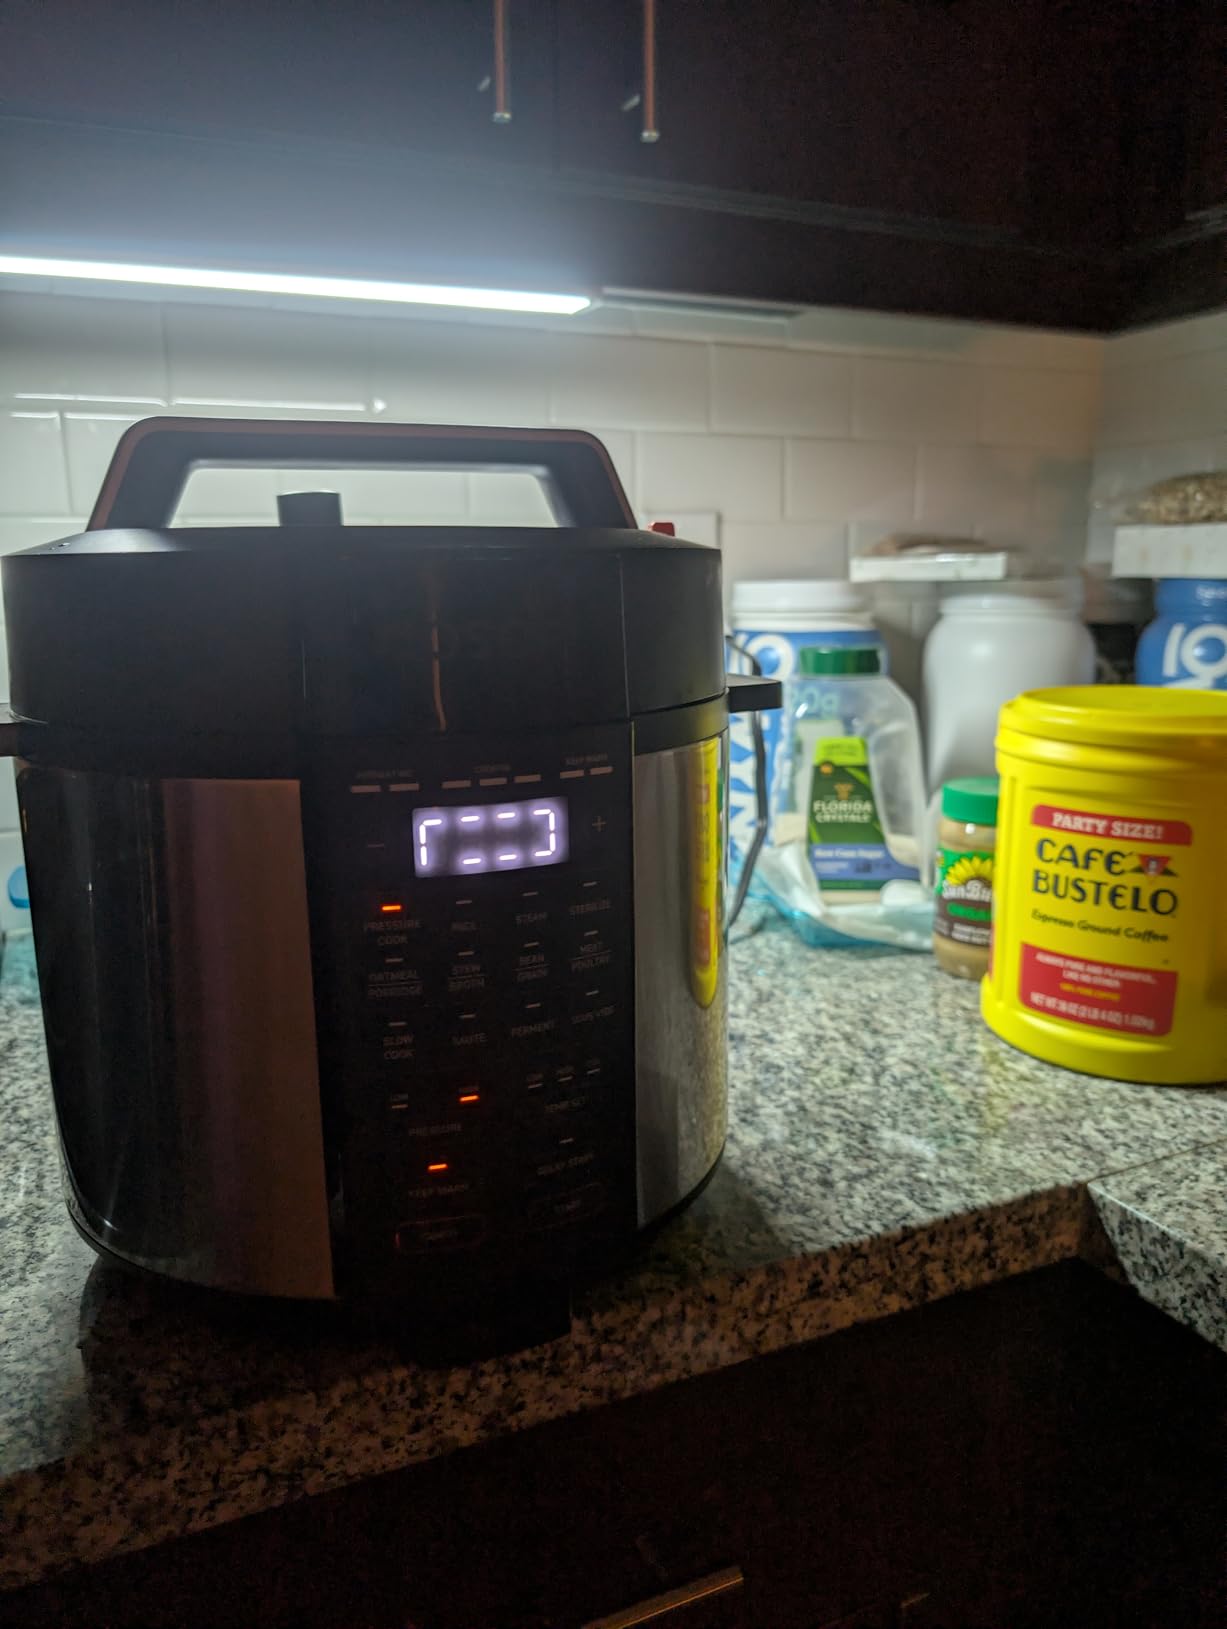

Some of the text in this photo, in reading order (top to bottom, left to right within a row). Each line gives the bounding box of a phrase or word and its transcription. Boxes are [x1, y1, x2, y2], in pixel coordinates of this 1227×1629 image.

[813, 800, 872, 813] FLORIDA
[1053, 812, 1164, 841] PARTY SIZE!
[1032, 869, 1179, 916] BUSTELO
[515, 911, 548, 925] STEAM
[364, 919, 423, 931] PRESSURE
[1031, 909, 1169, 943] Espresso Ground Coffee
[377, 935, 409, 946] COOK
[367, 969, 420, 981] OATMEAL
[450, 963, 482, 976] STEW
[511, 1019, 557, 1038] FERMENT
[383, 1034, 414, 1046] SLOW
[383, 1048, 416, 1060] COOK
